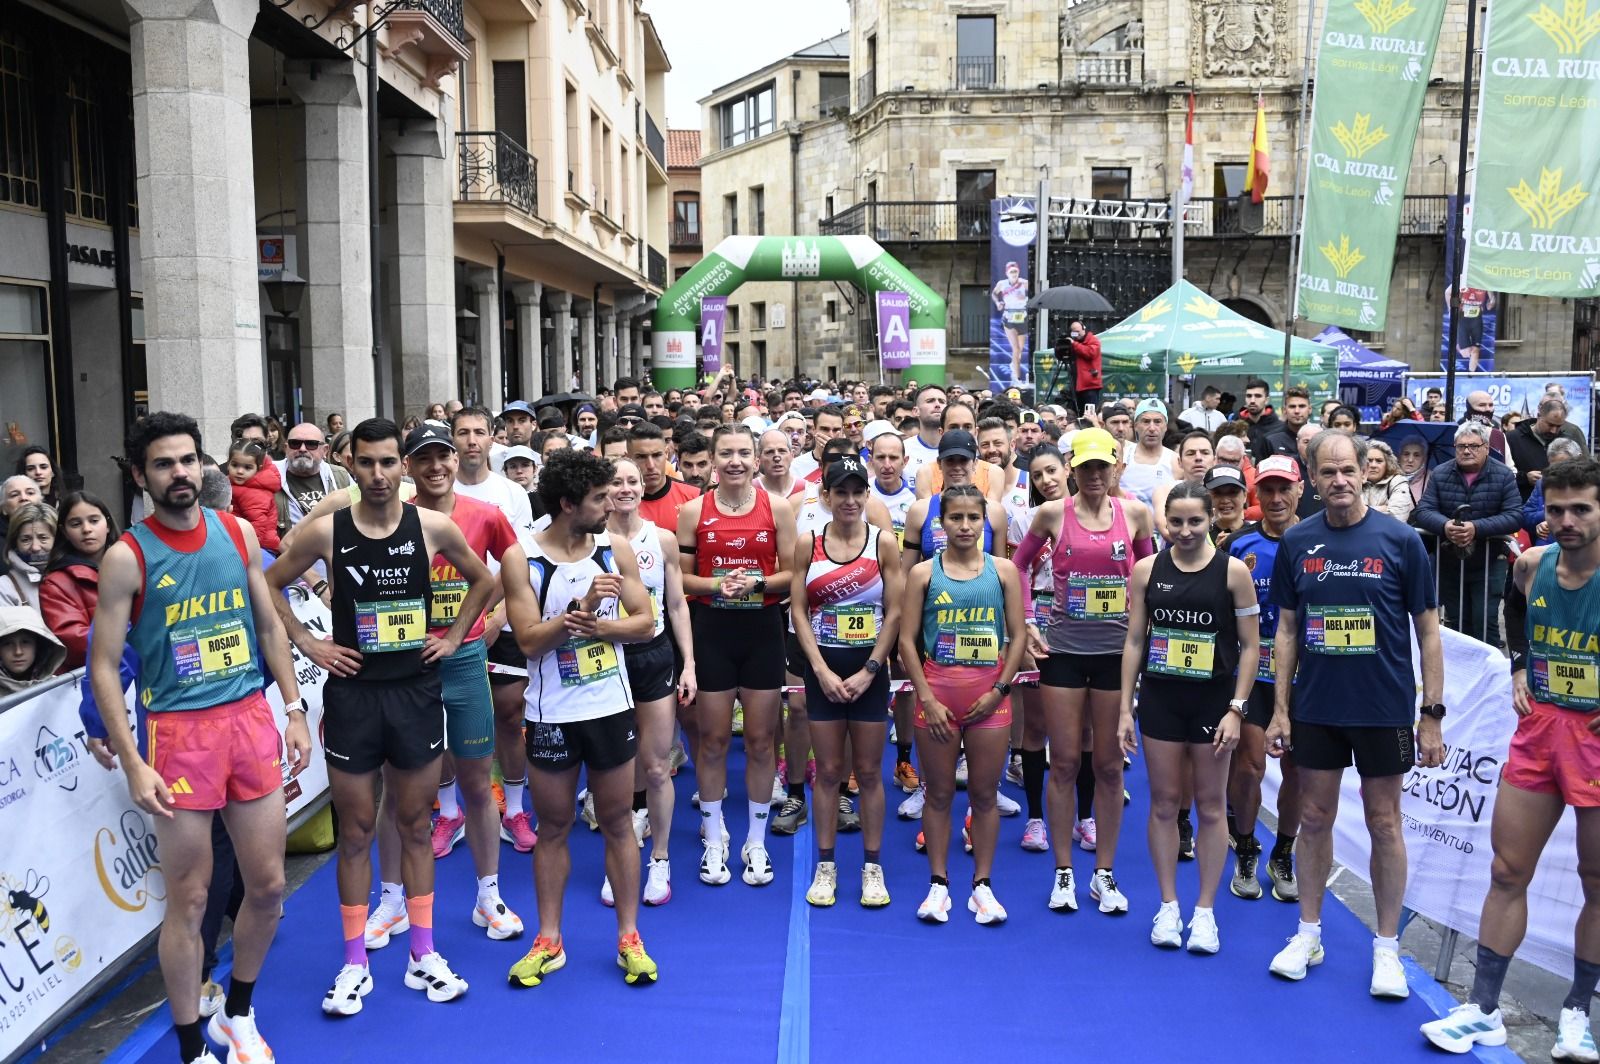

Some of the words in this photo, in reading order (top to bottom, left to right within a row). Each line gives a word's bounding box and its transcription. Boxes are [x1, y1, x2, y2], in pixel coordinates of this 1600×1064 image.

[1326, 32, 1366, 49] CAJA
[1370, 37, 1427, 56] RURAL
[1492, 57, 1550, 78] CAJA
[1504, 94, 1556, 108] somos
[1344, 161, 1398, 180] RURAL
[1475, 229, 1524, 250] CAJA
[868, 266, 884, 280] DE
[672, 261, 727, 309] AYUNTAMIENTO
[874, 262, 929, 306] AYUNTAMIENTO
[1334, 280, 1378, 300] RURAL
[678, 303, 692, 316] DE
[692, 268, 733, 305] ATORGA
[702, 304, 724, 312] SALIDA
[881, 298, 910, 308] SALIDA
[702, 320, 718, 346] A
[884, 314, 909, 344] A
[882, 350, 910, 360] SALIDA
[1340, 370, 1372, 378] RUNNING
[372, 566, 411, 578] VICKY
[825, 566, 866, 592] DESPENSA
[377, 578, 408, 586] FOODS
[434, 592, 461, 604] GIMENO
[834, 582, 864, 600] FER
[1096, 590, 1116, 600] MARTA
[166, 588, 246, 627] BIKILA
[443, 606, 454, 617] 11
[1102, 602, 1108, 612] 9
[388, 614, 414, 626] DANIEL
[848, 616, 864, 630] 28
[936, 608, 995, 624] BIKILA
[1154, 608, 1212, 625] OYSHO
[1326, 620, 1343, 630] ABEL
[1344, 618, 1370, 630] ANTÓN
[398, 628, 406, 640] 8
[1344, 633, 1350, 645] 1
[1534, 624, 1600, 653] BIKILA
[208, 634, 240, 652] ROSADO
[960, 637, 992, 647] TISALEMA
[1182, 642, 1198, 654] LUCI
[587, 644, 606, 658] KEVIN
[972, 649, 978, 660] 4
[223, 652, 232, 666] 5
[595, 659, 602, 671] 3
[1184, 656, 1192, 668] 6
[1556, 665, 1585, 680] CELADA
[1566, 681, 1574, 694] 2
[1402, 772, 1428, 798] DE
[1426, 777, 1485, 822] LEÓN
[10, 1000, 26, 1021] 925
[26, 974, 62, 1006] FILIEL
